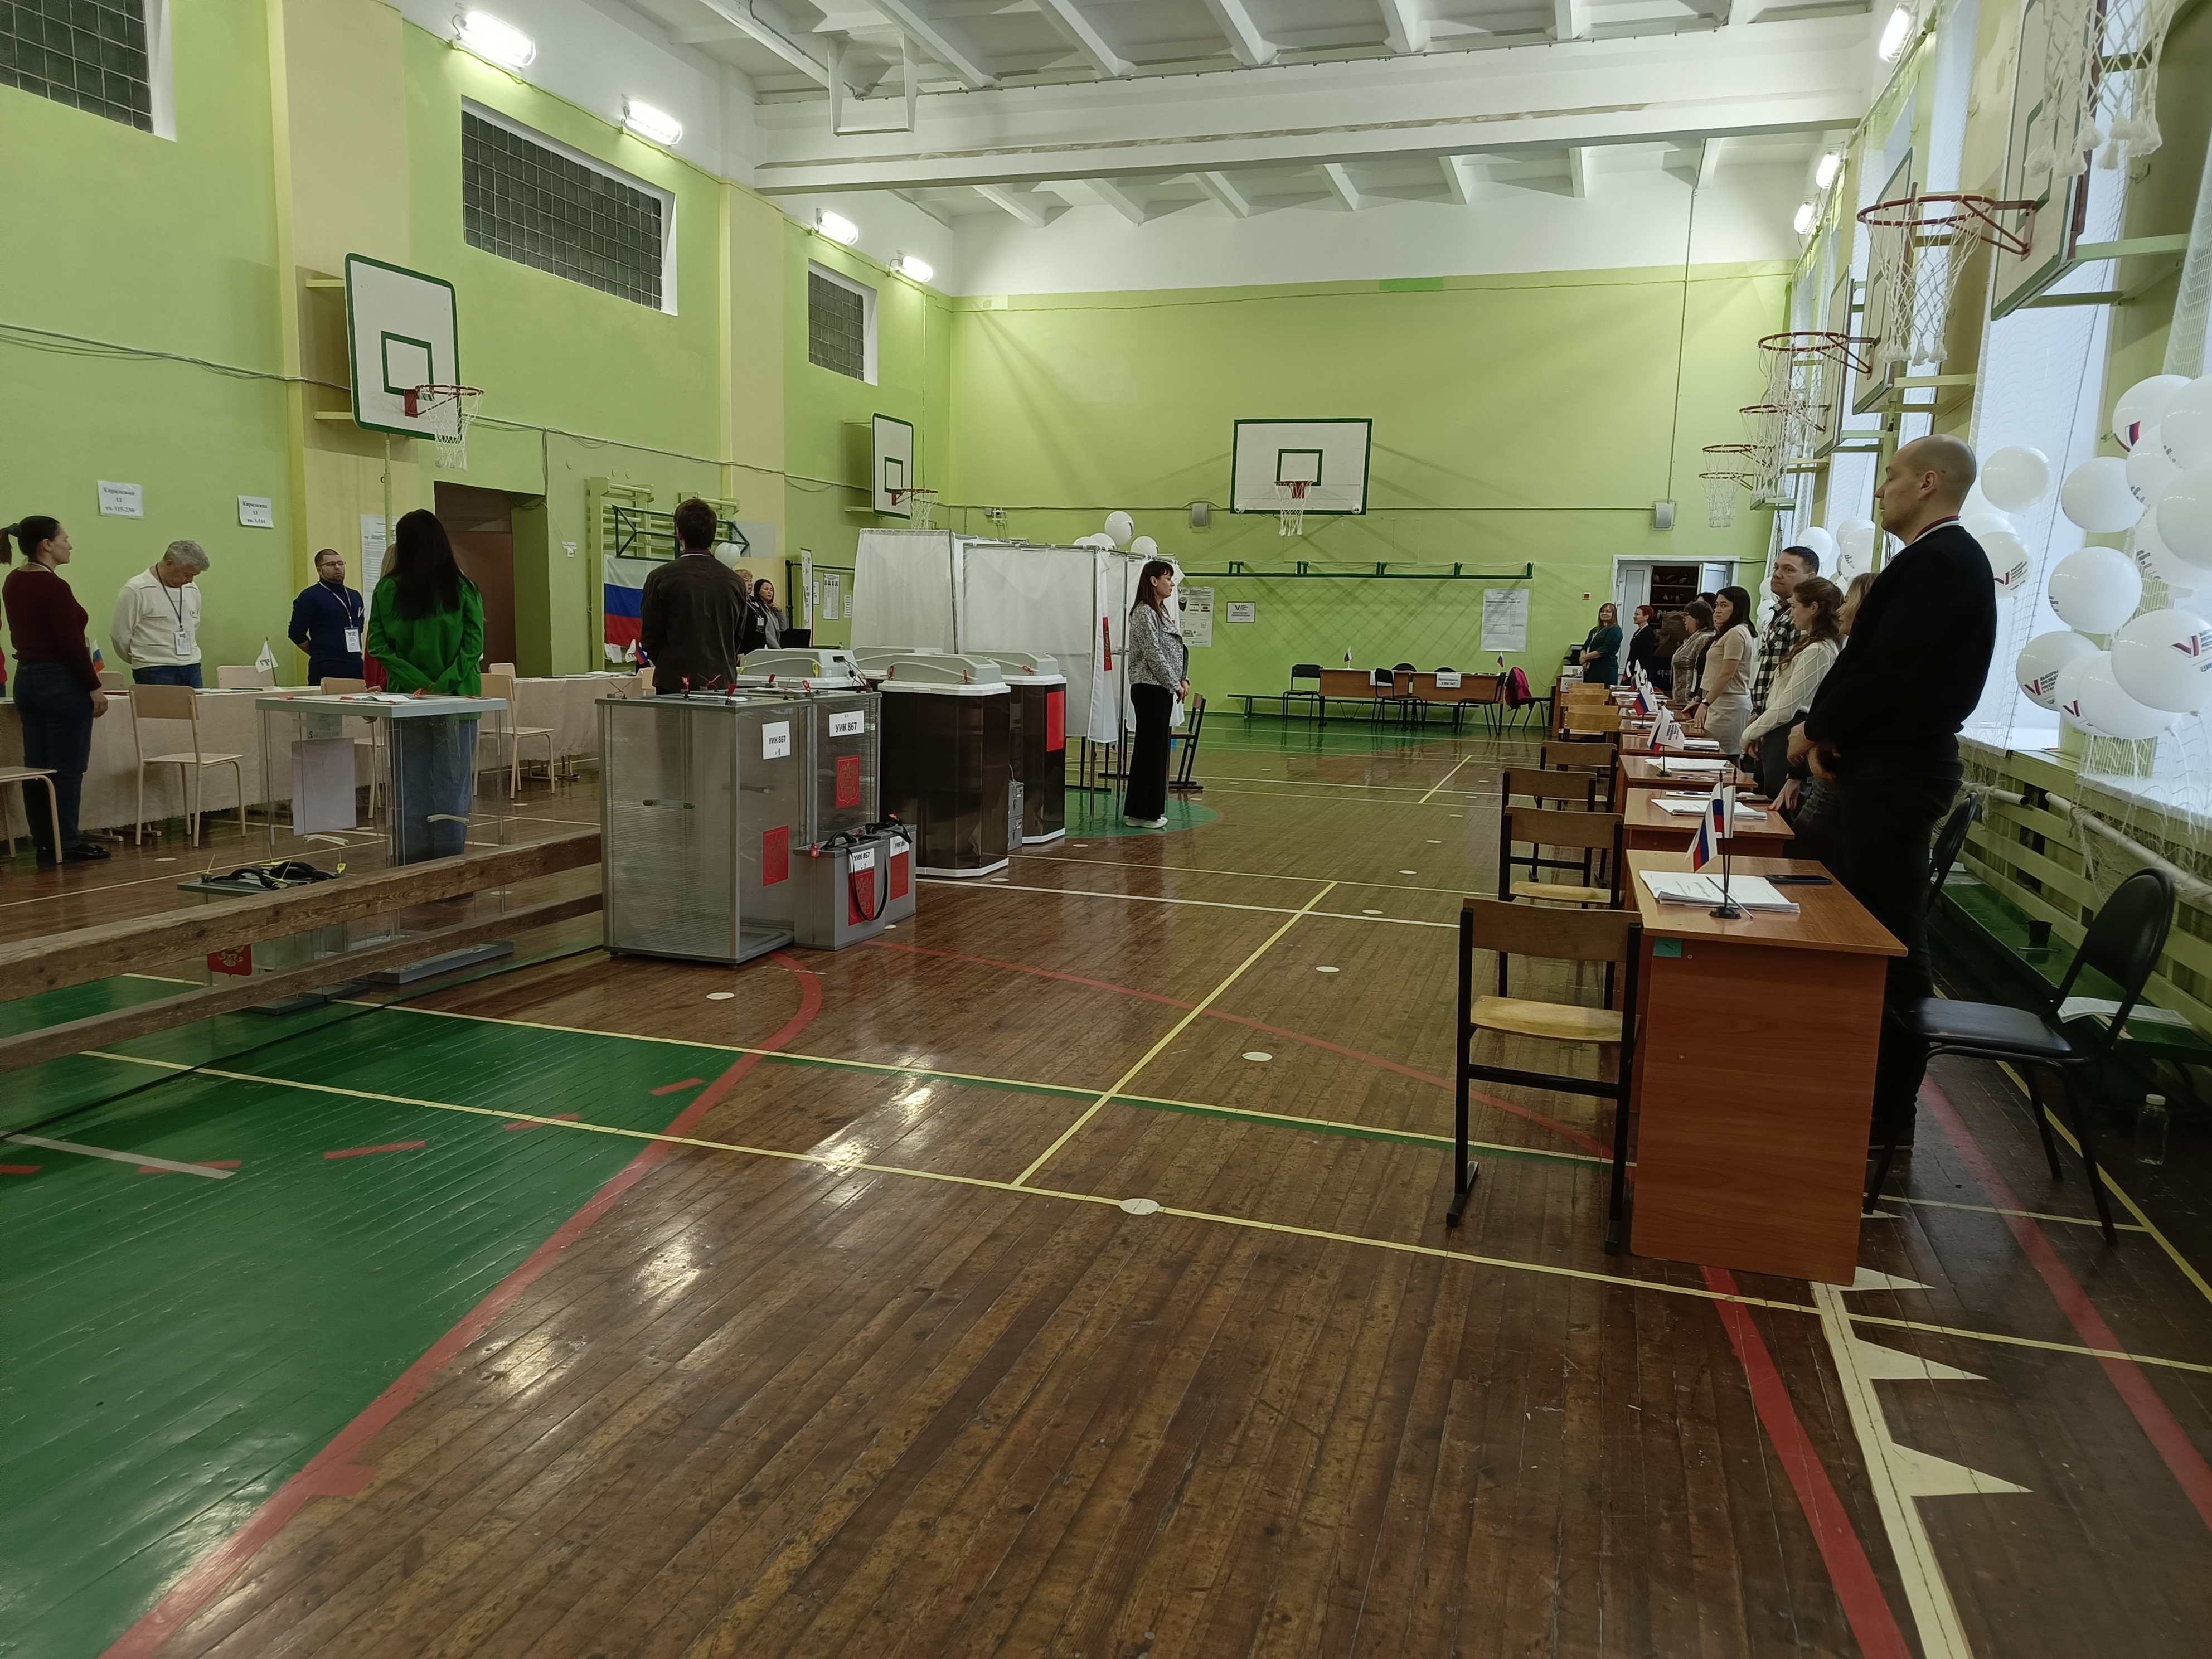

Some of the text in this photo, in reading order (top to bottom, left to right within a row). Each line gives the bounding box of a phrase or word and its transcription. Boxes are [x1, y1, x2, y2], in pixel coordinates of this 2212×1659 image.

[835, 721, 857, 733] УИК 867
[768, 735, 787, 745] УИК 867
